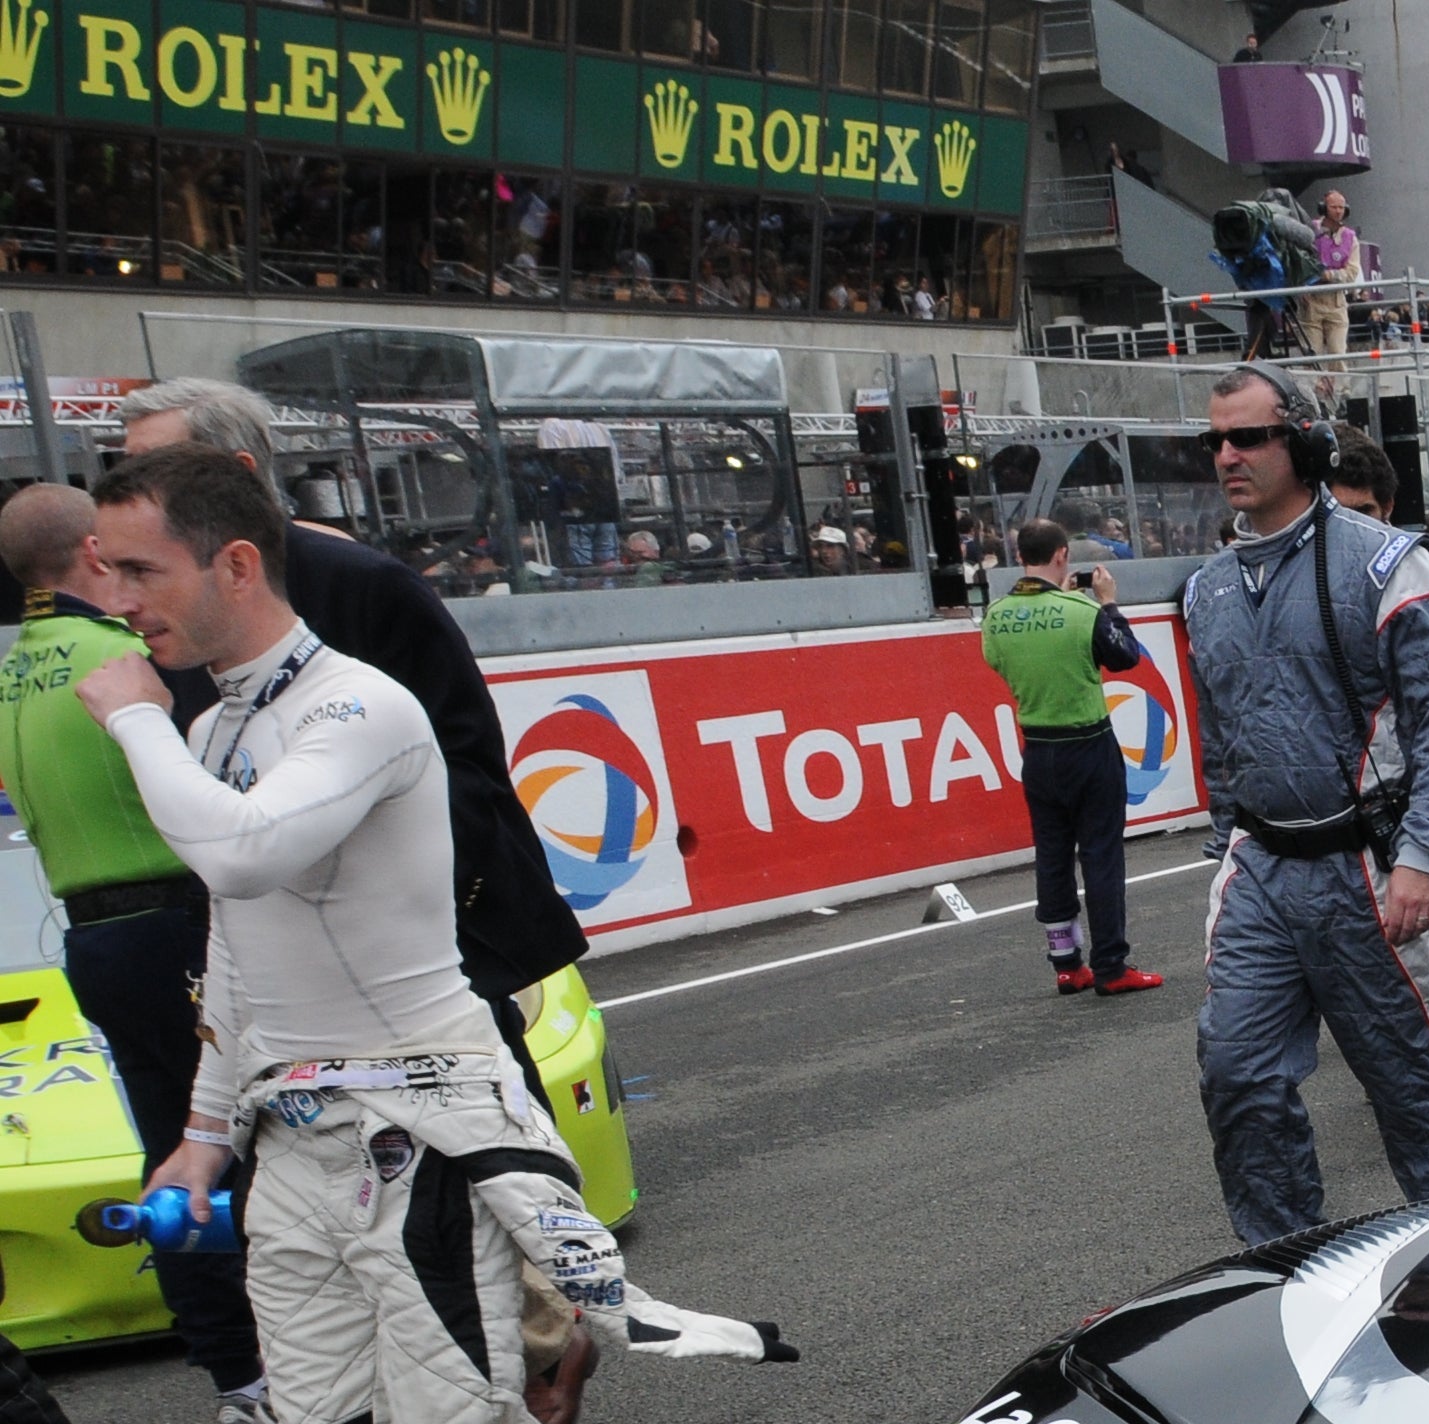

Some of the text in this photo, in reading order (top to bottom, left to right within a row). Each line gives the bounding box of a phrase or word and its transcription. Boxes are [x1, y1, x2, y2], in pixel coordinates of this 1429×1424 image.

[79, 15, 405, 129] ROLEX
[713, 103, 921, 187] ROLEX
[1375, 535, 1410, 574] sparco
[989, 618, 1065, 635] RACING
[990, 605, 1064, 622] KROHN
[1, 641, 77, 678] ROHN
[697, 703, 1023, 833] TOTAL
[945, 893, 969, 912] 92
[553, 1256, 569, 1268] LE
